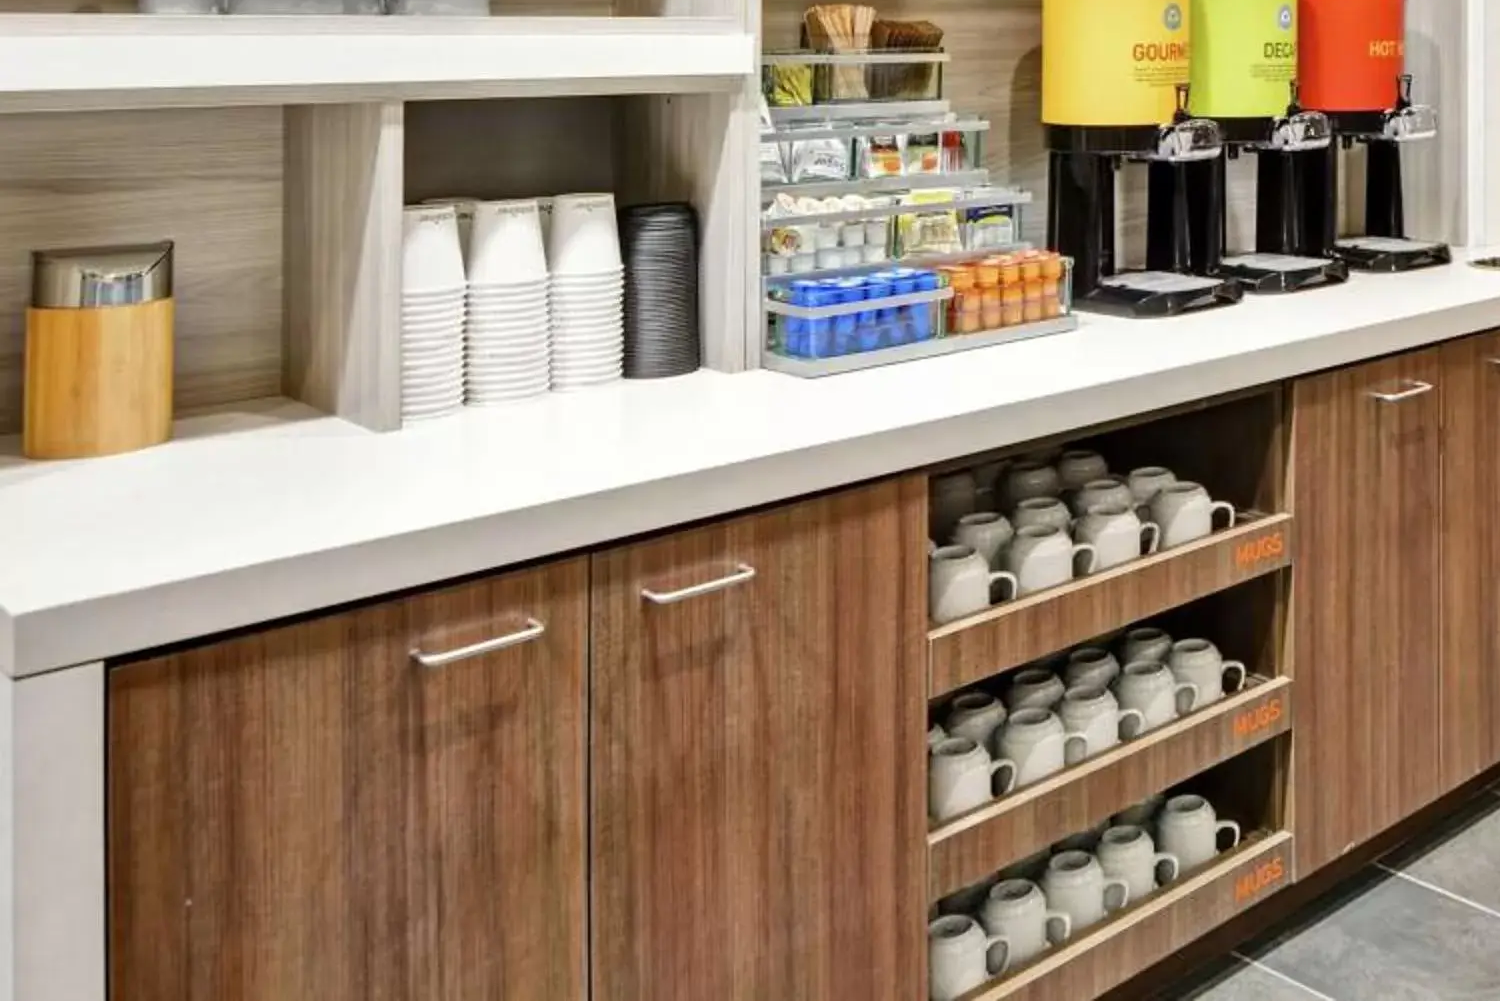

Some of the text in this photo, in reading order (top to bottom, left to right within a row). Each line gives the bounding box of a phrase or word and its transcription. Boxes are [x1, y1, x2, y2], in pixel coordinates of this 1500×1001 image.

[1369, 39, 1395, 56] HOT
[1235, 535, 1283, 567] MUGS
[1234, 701, 1281, 734] MUGS
[1235, 860, 1283, 900] MUGS
